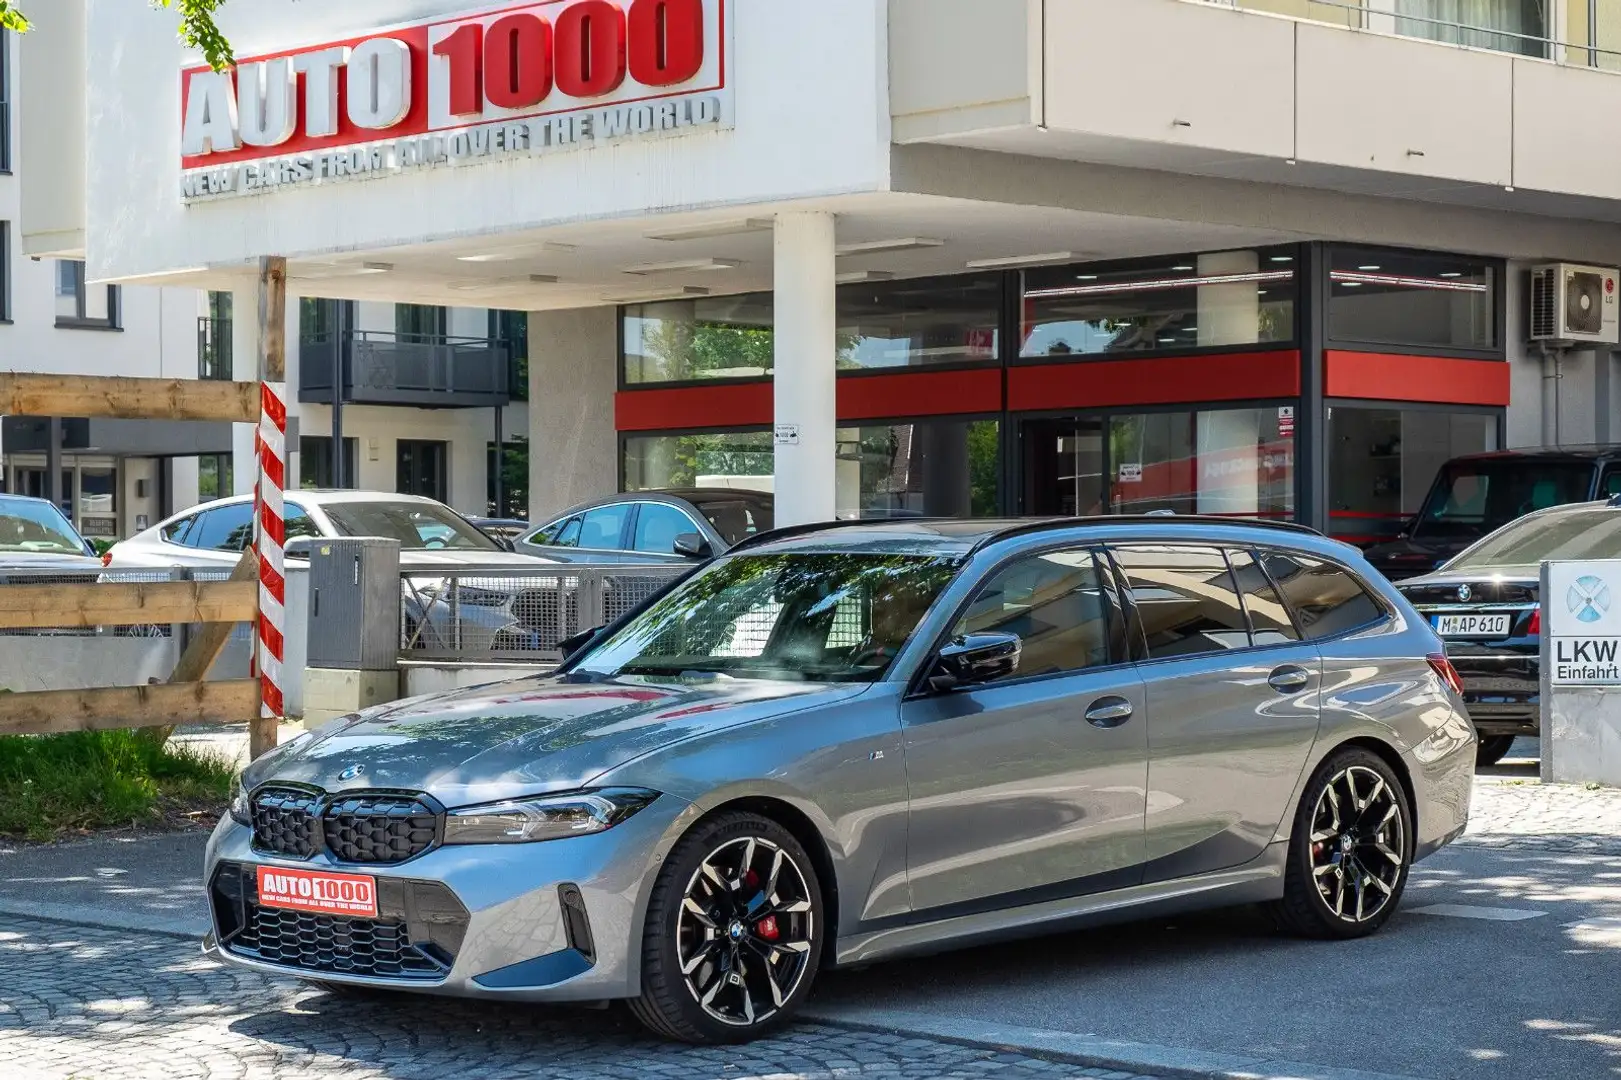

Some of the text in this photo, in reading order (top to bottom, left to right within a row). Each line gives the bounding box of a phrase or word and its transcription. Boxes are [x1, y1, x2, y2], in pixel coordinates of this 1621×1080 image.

[181, 0, 704, 157] AUTO 1000
[180, 168, 237, 198] NEW
[238, 157, 314, 194] CARS
[313, 145, 394, 179] FROM
[449, 124, 530, 158] OVER
[530, 113, 594, 146] THE
[600, 97, 720, 138] WORLD
[1442, 617, 1503, 632] M AP 610
[1557, 640, 1618, 662] LKW
[1557, 664, 1618, 679] Einfahrt
[263, 874, 369, 902] AUTO 1000
